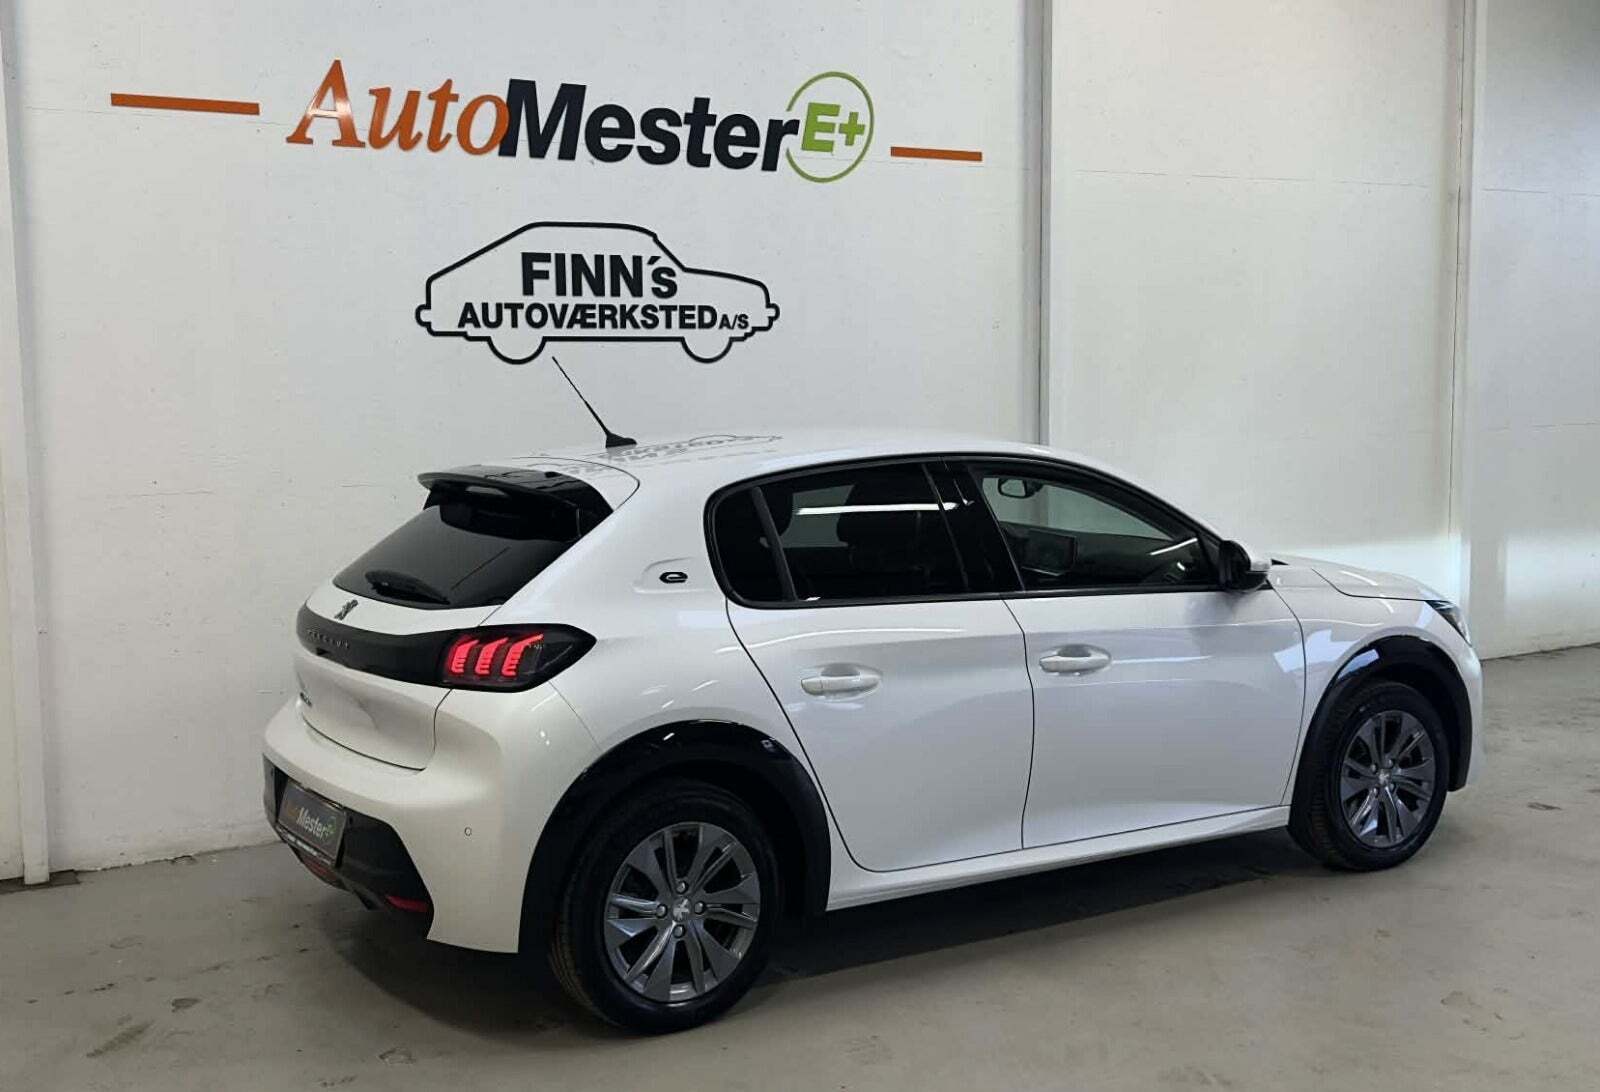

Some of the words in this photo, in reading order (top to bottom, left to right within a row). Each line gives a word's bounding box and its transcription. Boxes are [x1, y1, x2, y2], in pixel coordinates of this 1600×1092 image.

[286, 59, 801, 172] AutoMester
[801, 102, 866, 153] E+
[457, 302, 718, 330] AUTOVÆRKSTED
[718, 313, 750, 330] A/S
